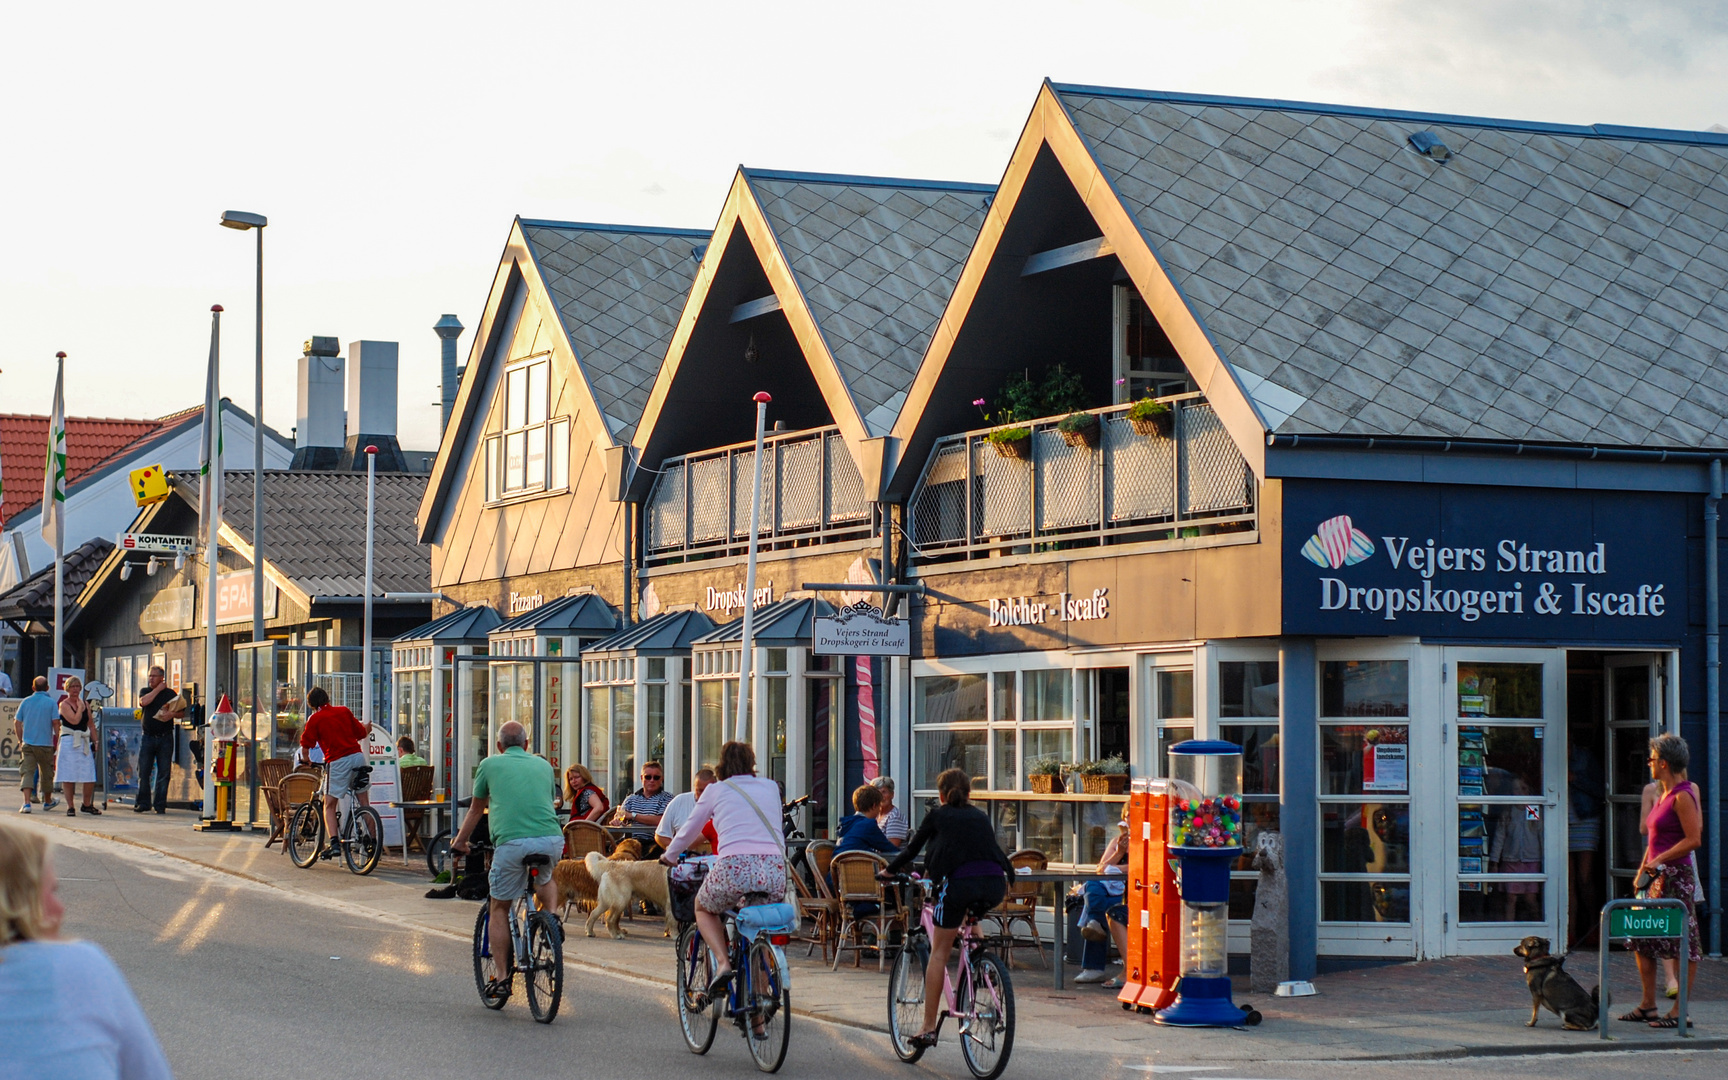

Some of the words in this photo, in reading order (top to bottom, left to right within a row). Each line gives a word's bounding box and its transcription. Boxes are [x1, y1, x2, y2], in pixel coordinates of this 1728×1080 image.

[138, 535, 192, 546] KONTANTEN
[1381, 536, 1486, 578] Vejers
[1497, 539, 1607, 575] Strand
[510, 589, 544, 613] Pizzaria
[706, 580, 772, 616] Dropskgeri
[988, 596, 1047, 627] Bolcher
[1059, 587, 1108, 622] Iscafé
[1319, 577, 1524, 622] Dropskogeri
[1533, 581, 1562, 616] &
[1571, 583, 1665, 617] Iscafé
[820, 637, 870, 648] Dropskogeri
[871, 639, 879, 647] &
[881, 638, 905, 649] Iscafé
[836, 628, 860, 640] Vejers
[862, 628, 889, 637] Strand
[1624, 914, 1670, 933] Nordvej
